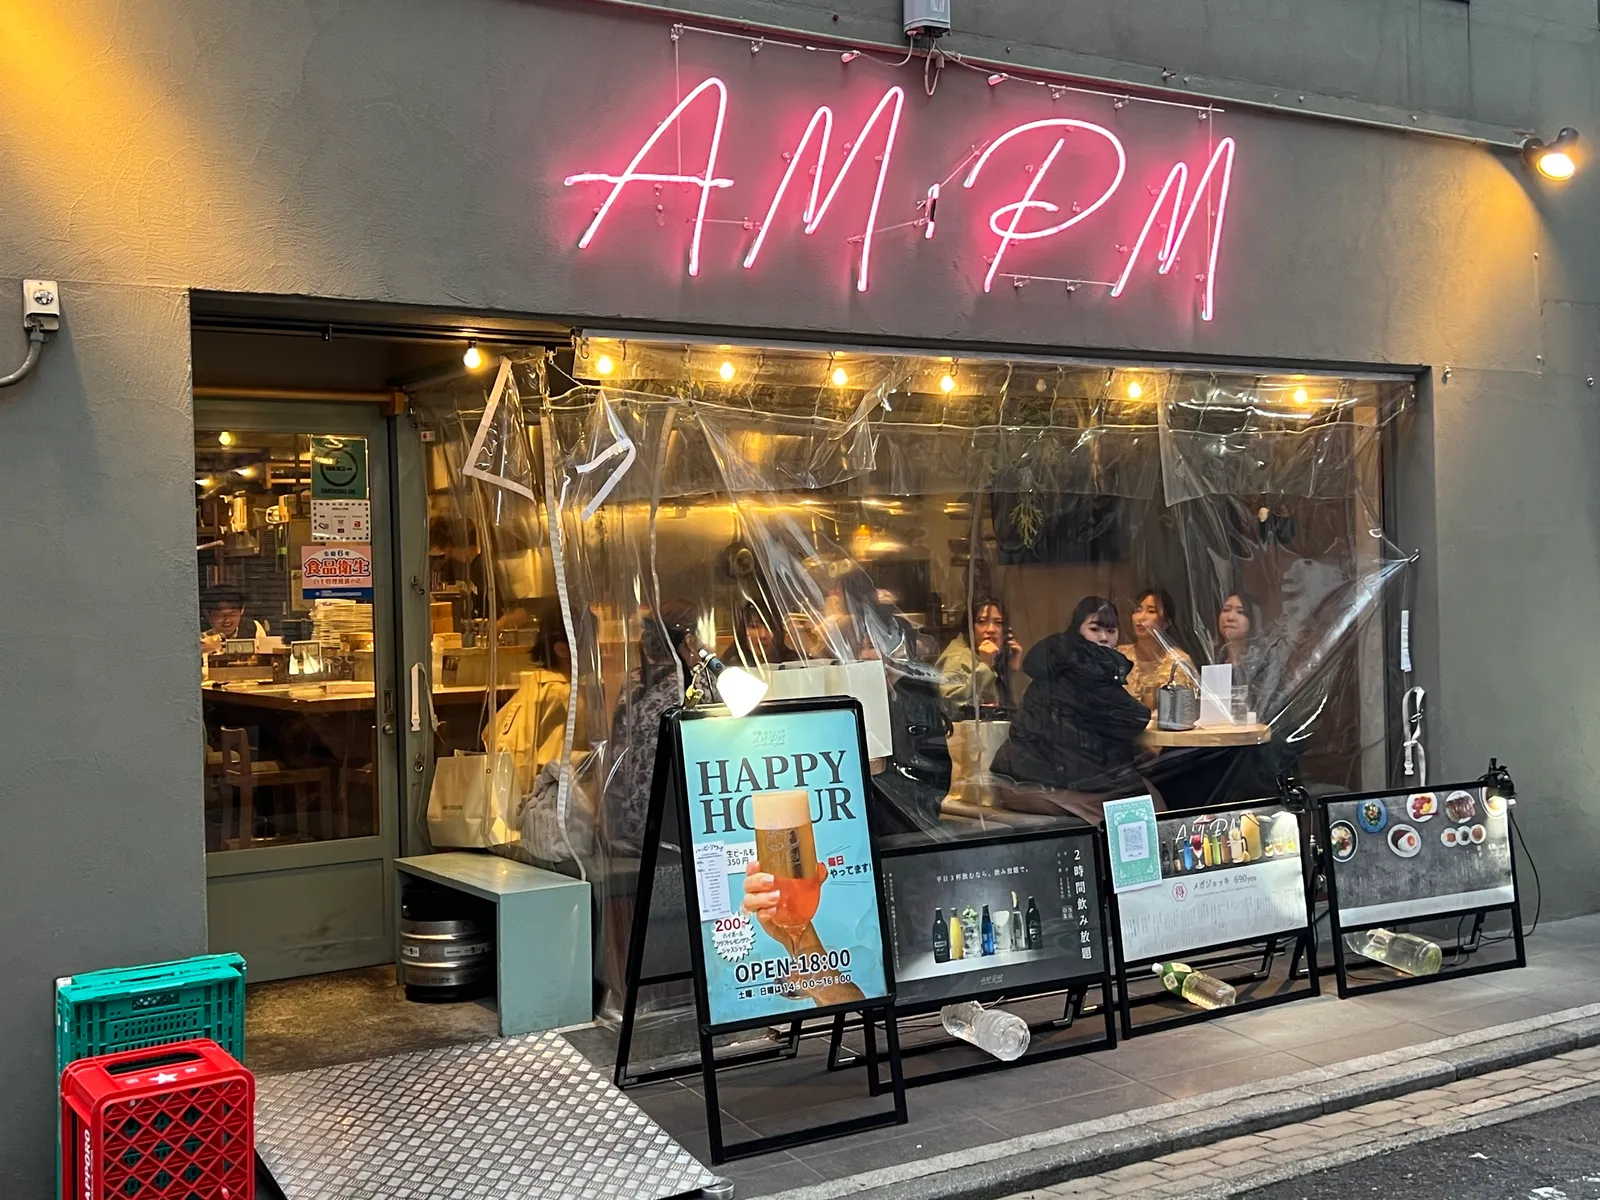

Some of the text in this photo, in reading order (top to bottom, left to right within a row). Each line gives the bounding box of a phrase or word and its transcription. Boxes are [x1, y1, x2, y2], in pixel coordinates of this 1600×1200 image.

[305, 558, 370, 577] 食品衛生
[695, 750, 847, 796] HAPPY
[1073, 849, 1093, 960] 2時間飲み放題
